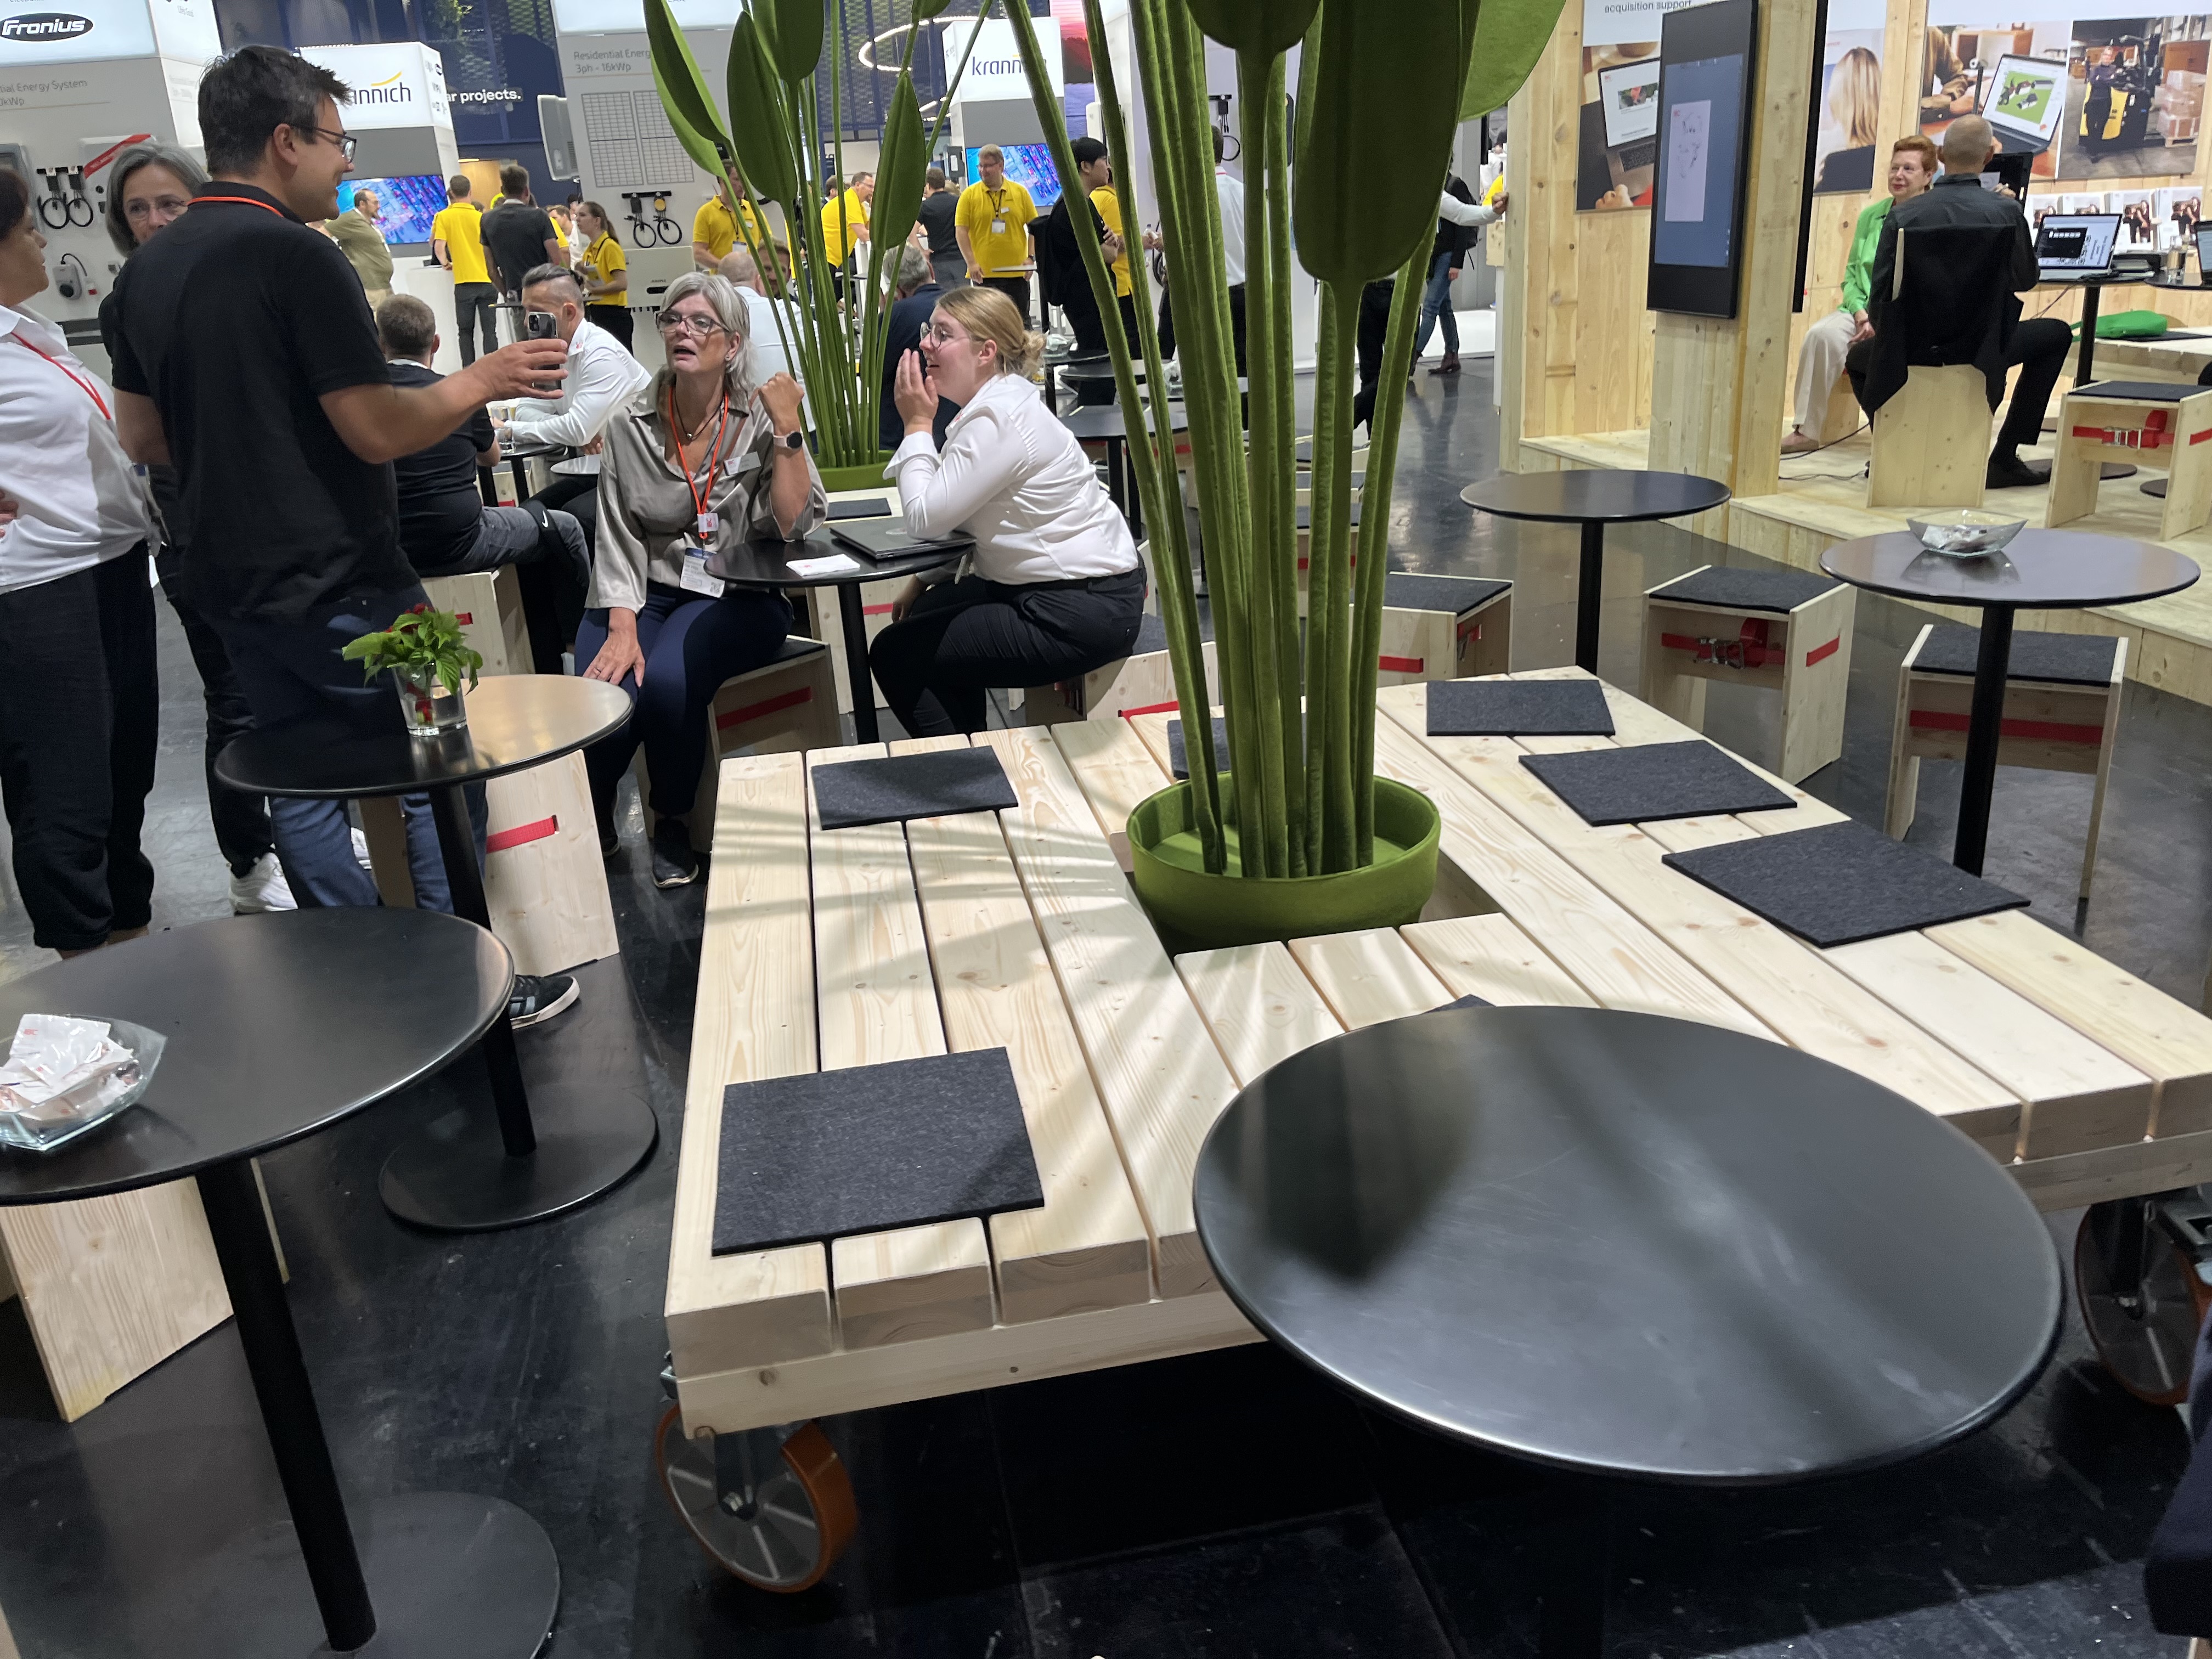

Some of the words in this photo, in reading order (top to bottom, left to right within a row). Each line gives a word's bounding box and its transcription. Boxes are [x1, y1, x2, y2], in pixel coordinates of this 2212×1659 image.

[1604, 2, 1654, 14] acquisition
[1656, 0, 1691, 10] support
[2, 18, 86, 36] Fronius
[573, 49, 624, 60] Residential
[575, 64, 593, 74] 3ph
[602, 63, 631, 72] 16kWp
[17, 83, 50, 93] Energy
[52, 80, 88, 91] System
[460, 89, 521, 104] projects.
